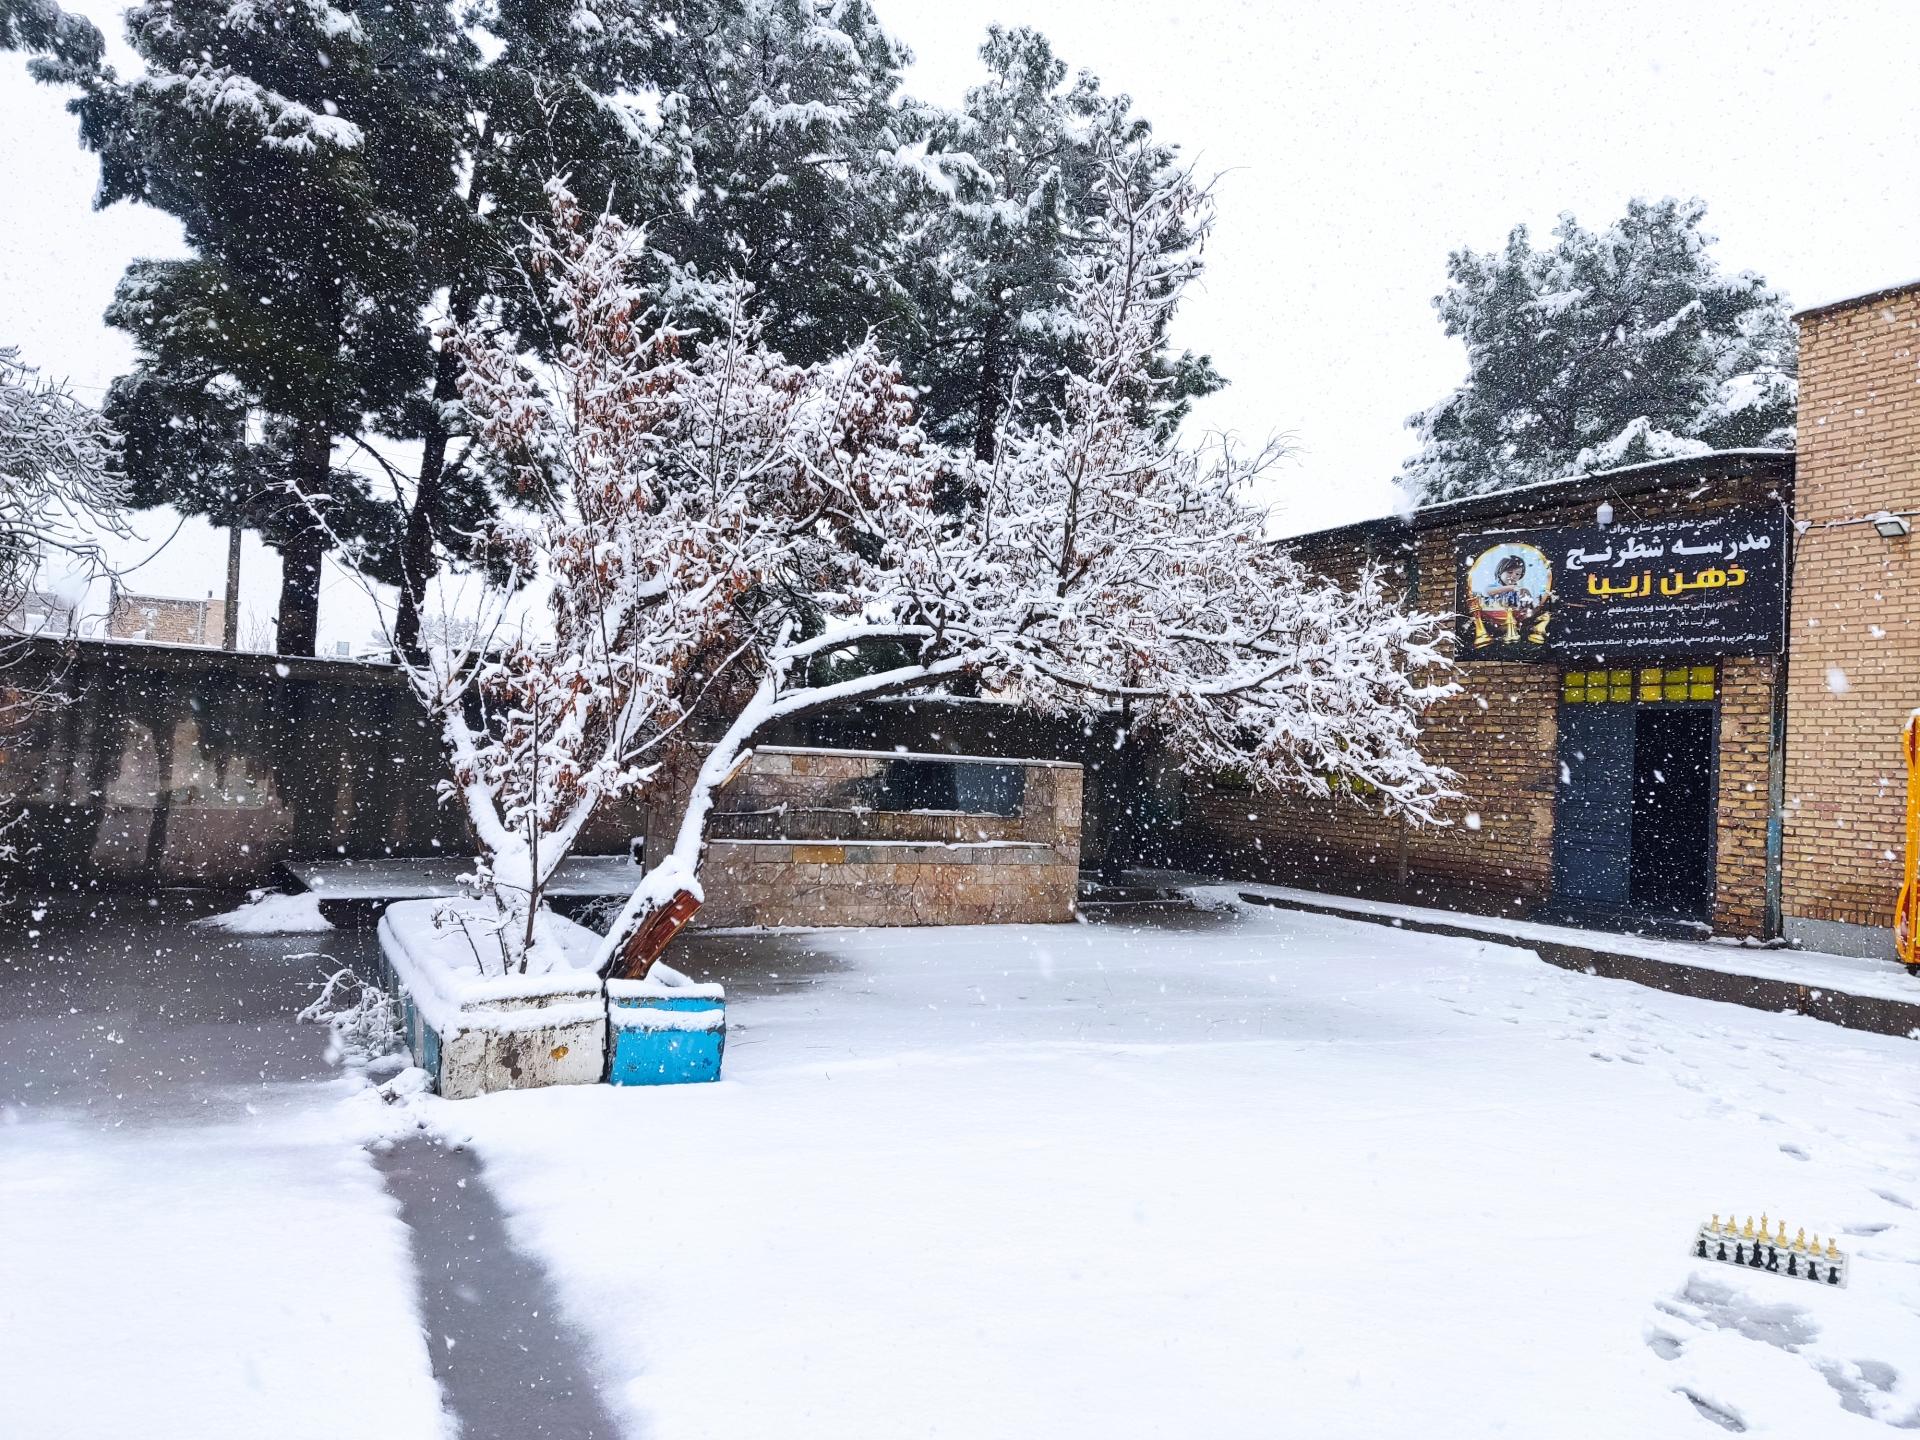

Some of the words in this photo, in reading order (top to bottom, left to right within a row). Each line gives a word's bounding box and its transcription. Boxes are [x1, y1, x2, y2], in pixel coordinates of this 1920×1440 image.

[1609, 522, 1631, 535] خواف
[1633, 521, 1666, 533] شهرستان
[1667, 519, 1696, 531] شطرنج
[1697, 516, 1722, 530] انجمن
[1566, 535, 1664, 570] شطرنج
[1671, 532, 1771, 560] مدرسه
[1587, 569, 1651, 598] زیبا
[1660, 563, 1747, 596] ذهن
[1625, 605, 1640, 613] تمام
[1743, 632, 1756, 642] نظر
